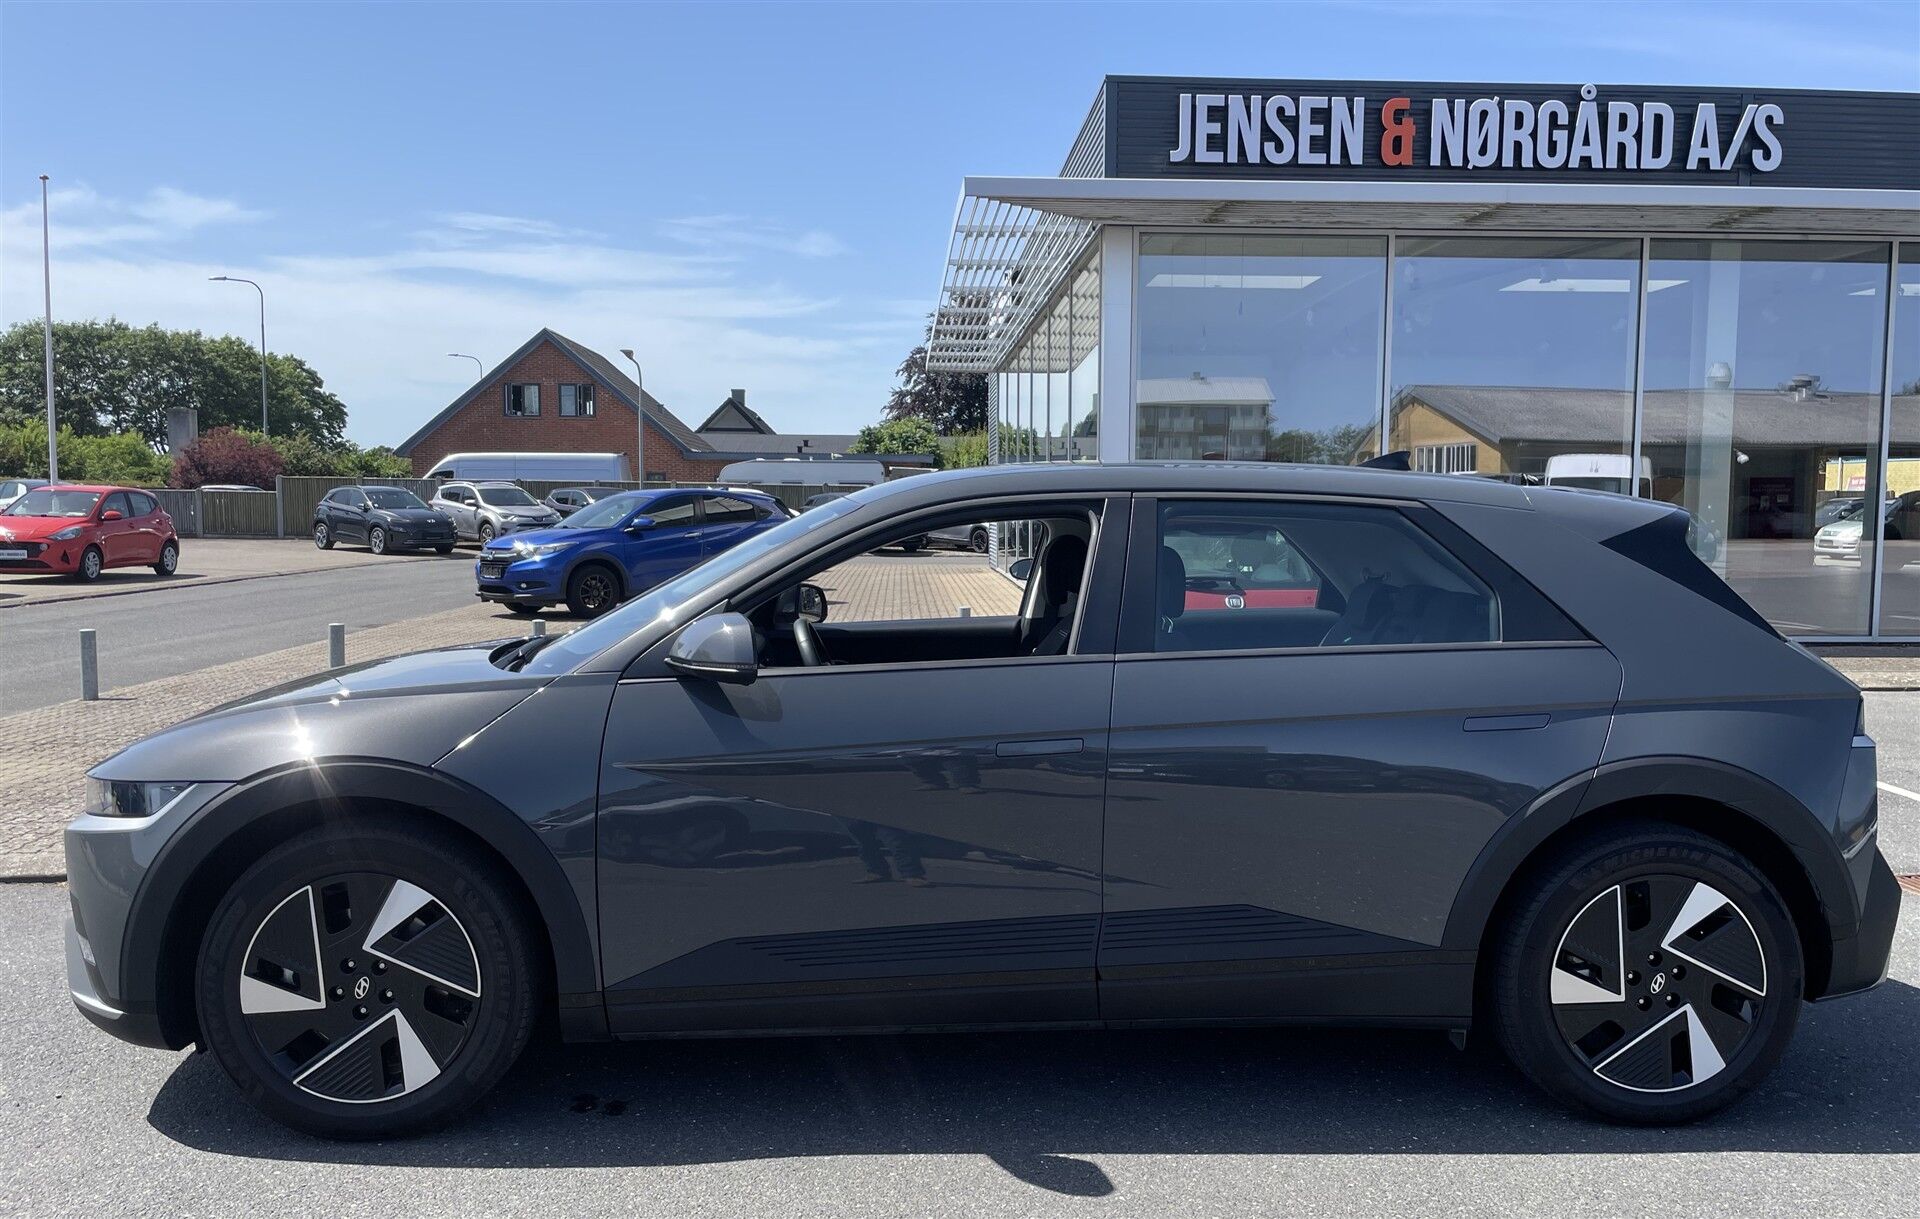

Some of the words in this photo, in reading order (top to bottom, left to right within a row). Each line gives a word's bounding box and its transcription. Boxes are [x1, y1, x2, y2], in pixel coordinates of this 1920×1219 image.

[1169, 93, 1366, 165] JENSEN
[1381, 97, 1416, 166] &
[1429, 83, 1675, 170] NØRGÅRD
[1686, 103, 1785, 172] A/S
